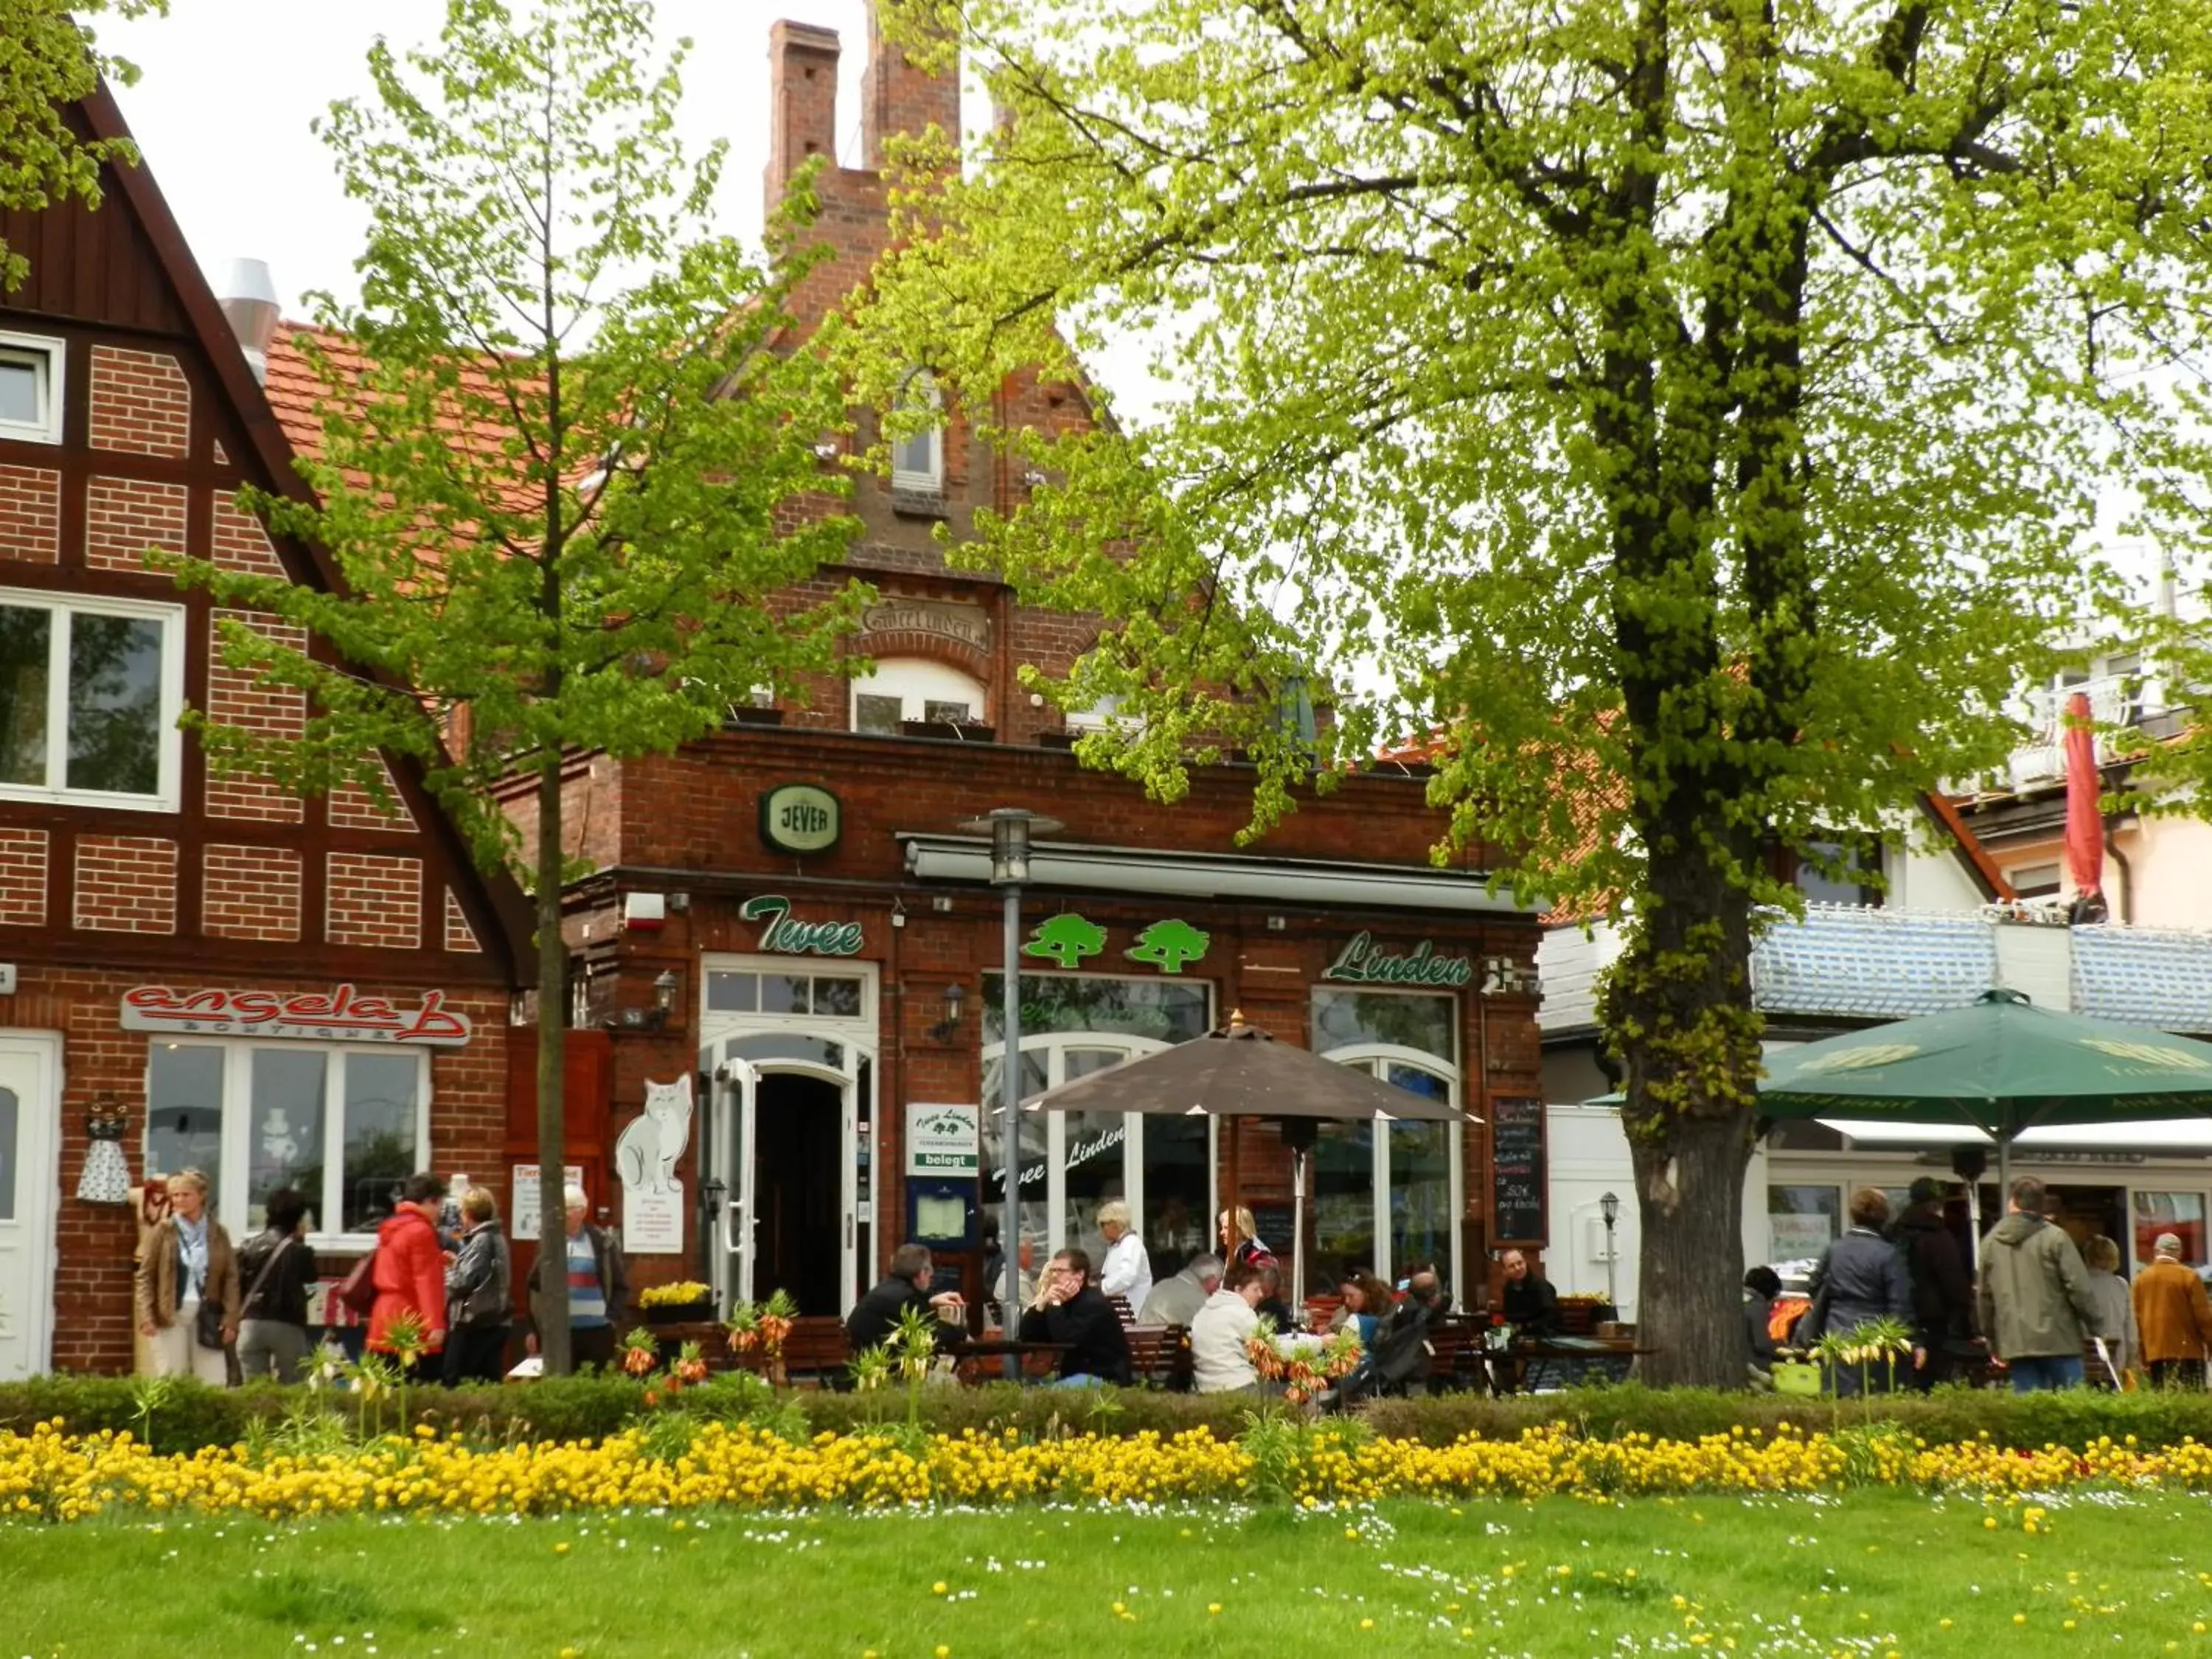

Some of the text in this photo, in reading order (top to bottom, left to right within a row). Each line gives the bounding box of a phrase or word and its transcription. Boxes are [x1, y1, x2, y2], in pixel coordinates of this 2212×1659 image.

[782, 805, 827, 832] JEVER
[739, 894, 1472, 986] Twee Linden
[125, 984, 401, 1024] angela
[925, 1154, 965, 1169] belegt
[1064, 1127, 1125, 1172] Linden
